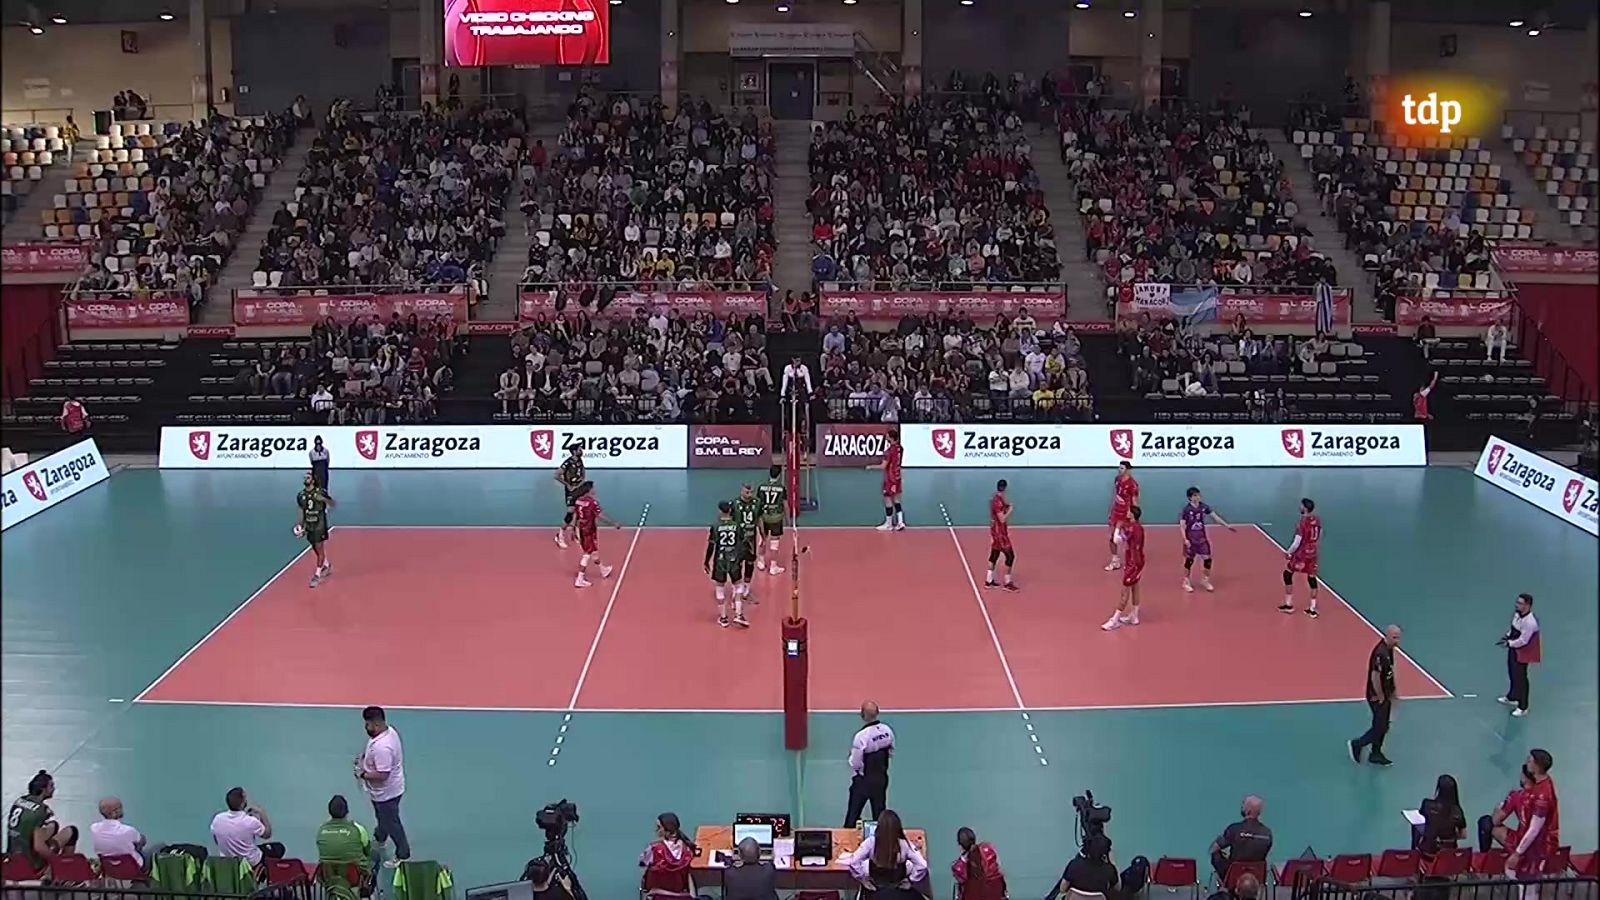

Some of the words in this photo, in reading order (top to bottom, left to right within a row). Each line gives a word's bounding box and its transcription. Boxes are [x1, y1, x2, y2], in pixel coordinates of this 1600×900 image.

[459, 12, 509, 23] VIDEO
[510, 11, 594, 22] CHECKING
[469, 24, 583, 35] TRABAJANDO
[50, 248, 80, 256] COPA
[149, 302, 178, 310] COPA
[266, 301, 297, 309] COPA
[340, 299, 371, 307] COPA
[217, 433, 307, 457] Zaragoza
[385, 433, 480, 457] Zaragoza
[562, 432, 659, 457] Zaragoza
[695, 437, 730, 445] COPA
[963, 432, 1061, 453] Zaragoza
[1141, 432, 1235, 455] Zaragoza
[1311, 431, 1400, 455] Zaragoza
[695, 448, 720, 456] S.M.
[722, 448, 737, 456] EL
[738, 448, 763, 456] REY
[40, 453, 96, 487] Zaragoza
[1502, 453, 1556, 492] Zaragoza
[765, 492, 778, 504] 17
[1581, 489, 1599, 514] Za
[743, 511, 753, 524] 14
[720, 532, 735, 545] 23
[10, 807, 23, 828] 8
